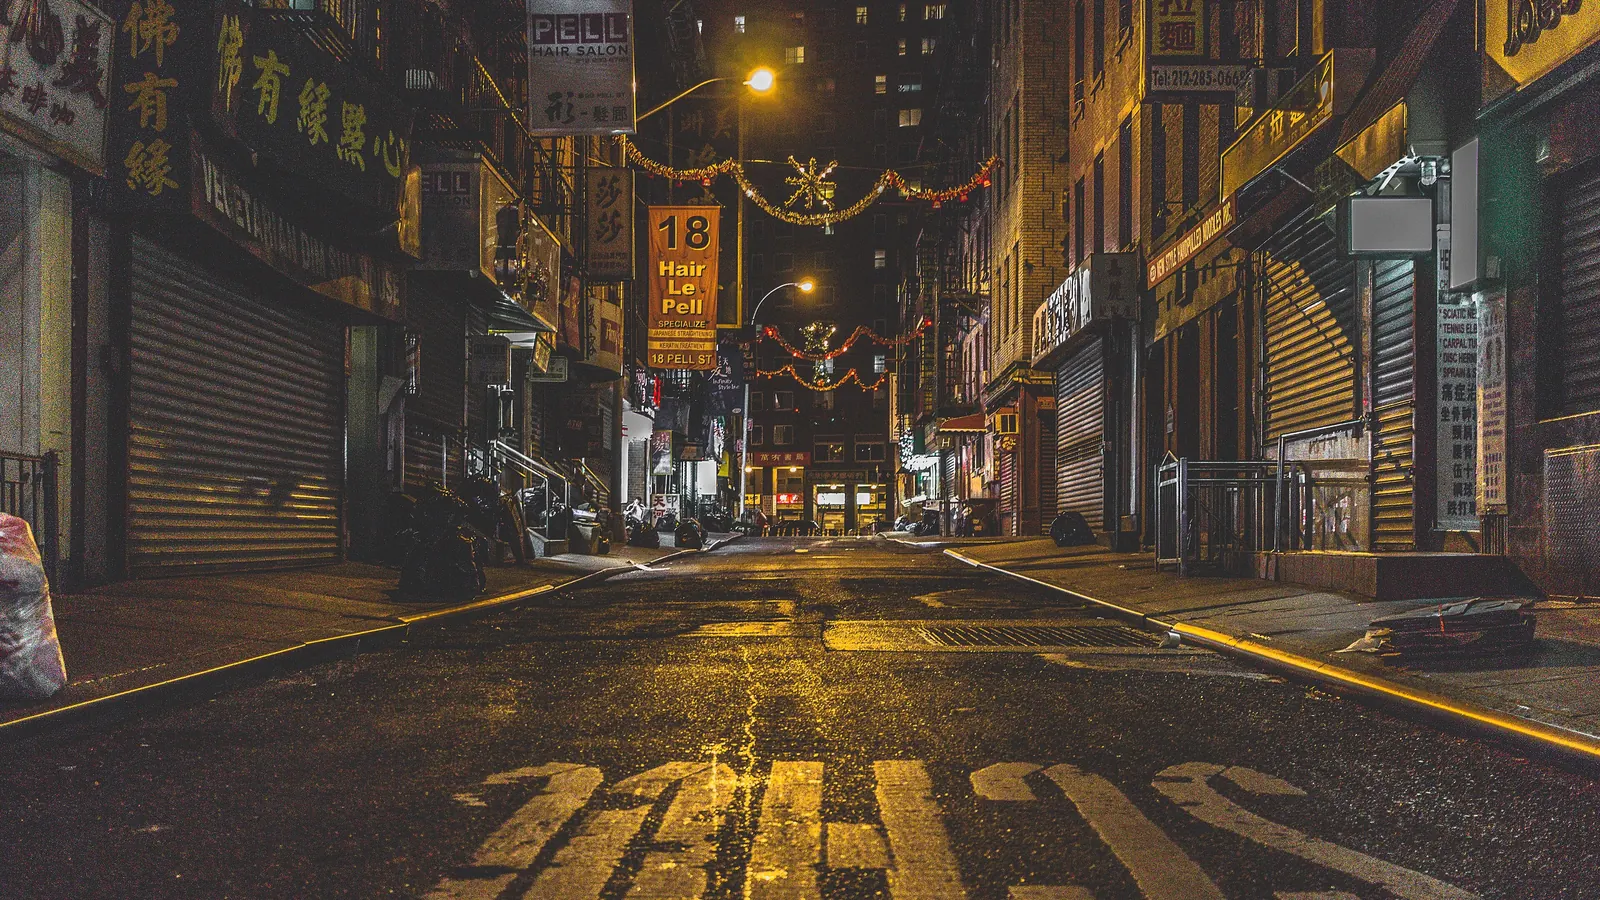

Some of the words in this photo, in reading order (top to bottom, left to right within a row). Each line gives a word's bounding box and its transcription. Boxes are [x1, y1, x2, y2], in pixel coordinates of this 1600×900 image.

[535, 17, 624, 41] PELL
[532, 46, 569, 57] HAIR
[577, 45, 628, 56] SALON
[122, 0, 181, 196] 佛有緣
[422, 174, 467, 192] ELL
[659, 215, 711, 251] 18
[1156, 256, 1165, 278] NEW
[1165, 247, 1177, 272] STYLE
[1202, 209, 1222, 243] NOODLES
[659, 260, 706, 278] Hair
[668, 279, 696, 296] Le
[662, 299, 703, 315] Pell
[1443, 308, 1466, 319] SCIATIC
[1467, 308, 1477, 319] NE
[658, 320, 706, 329] SPECIALIZE
[1443, 323, 1465, 334] TENNIS
[1466, 323, 1478, 334] ELB
[1443, 338, 1468, 349] CARPAL
[651, 354, 664, 364] 18
[667, 354, 697, 364] PELL
[697, 354, 713, 364] ST
[1443, 352, 1458, 363] DISC
[1443, 367, 1466, 378] SPRAIN
[1440, 406, 1476, 422] 坐骨神
[653, 496, 666, 519] 天河
